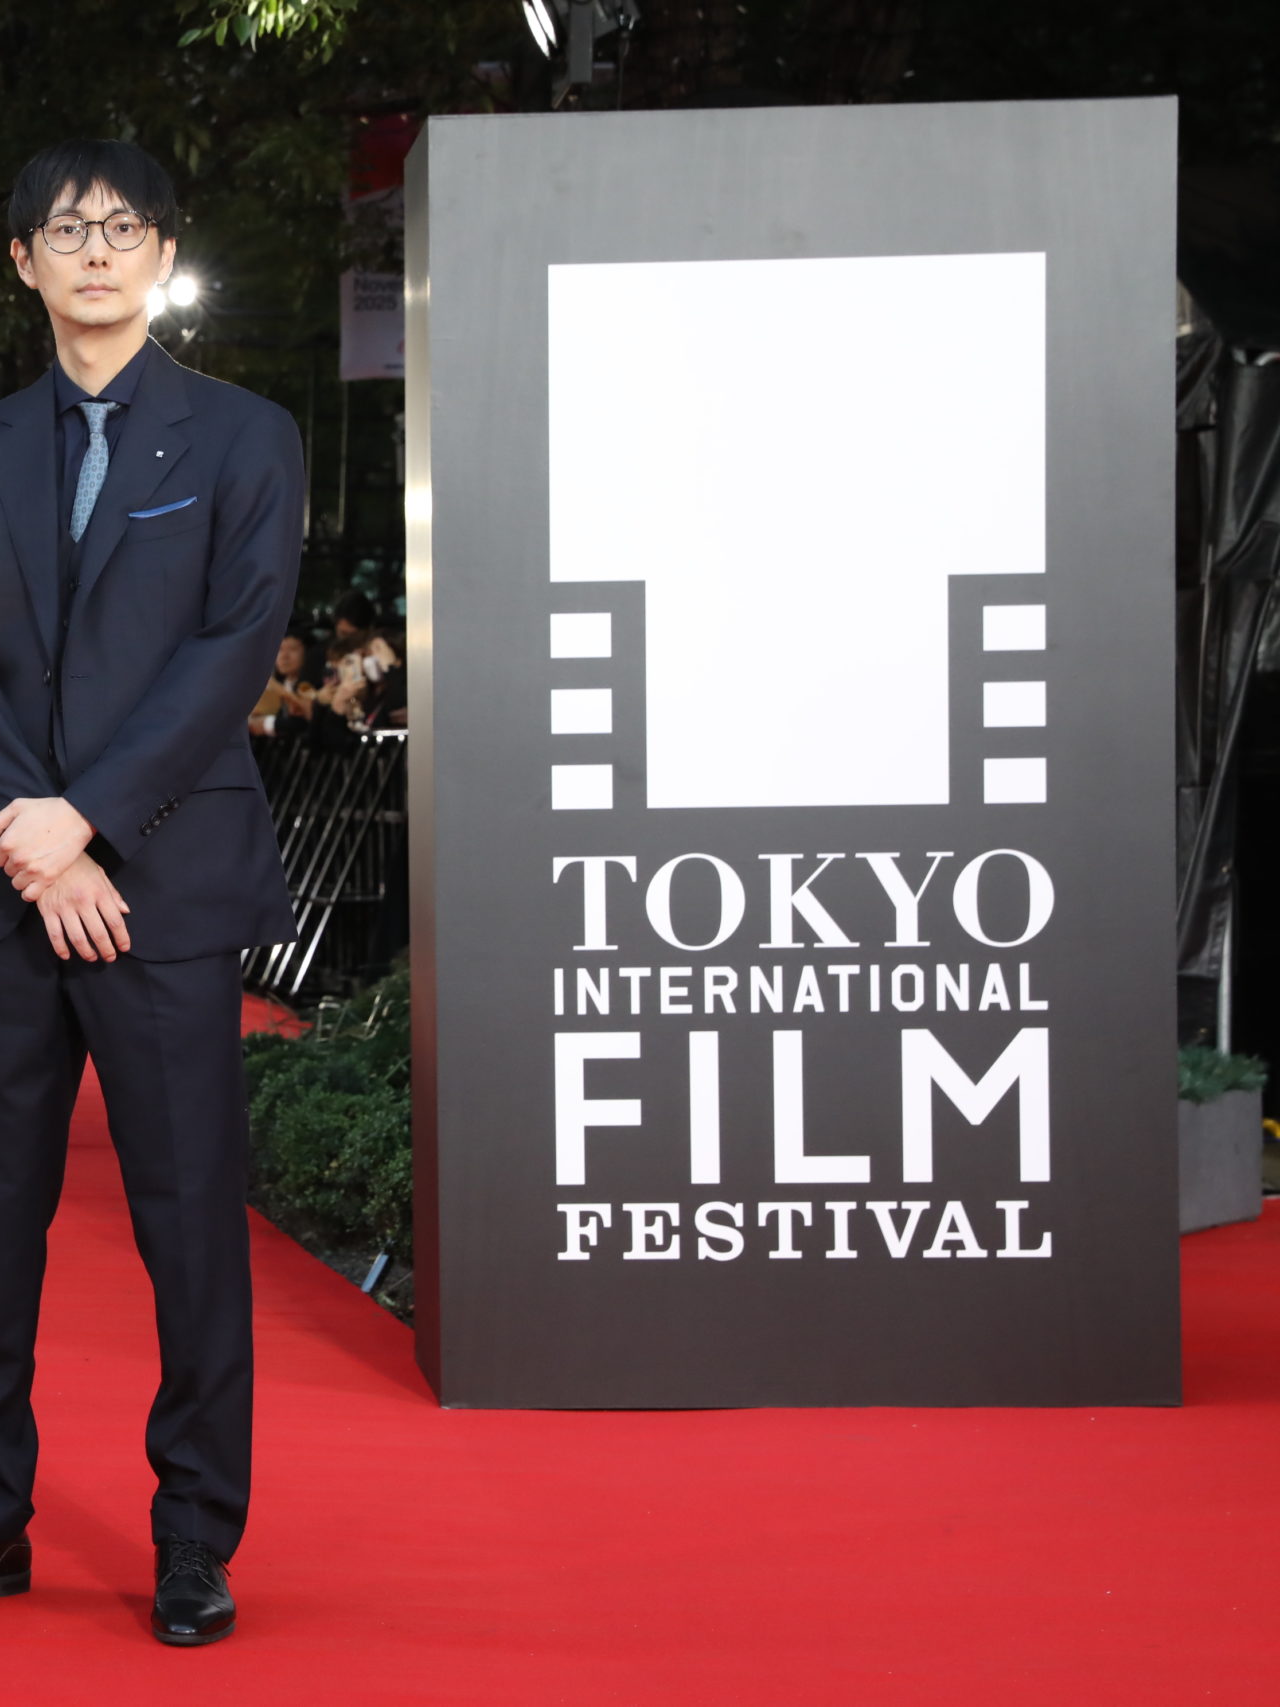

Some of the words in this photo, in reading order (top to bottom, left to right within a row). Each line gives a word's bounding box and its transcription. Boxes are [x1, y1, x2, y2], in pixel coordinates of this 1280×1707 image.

[353, 295, 399, 311] 2025
[552, 848, 1055, 951] TOKYO
[553, 962, 1049, 1015] INTERNATIONAL
[554, 1027, 1051, 1185] FILM
[556, 1200, 1052, 1262] FESTIVAL
